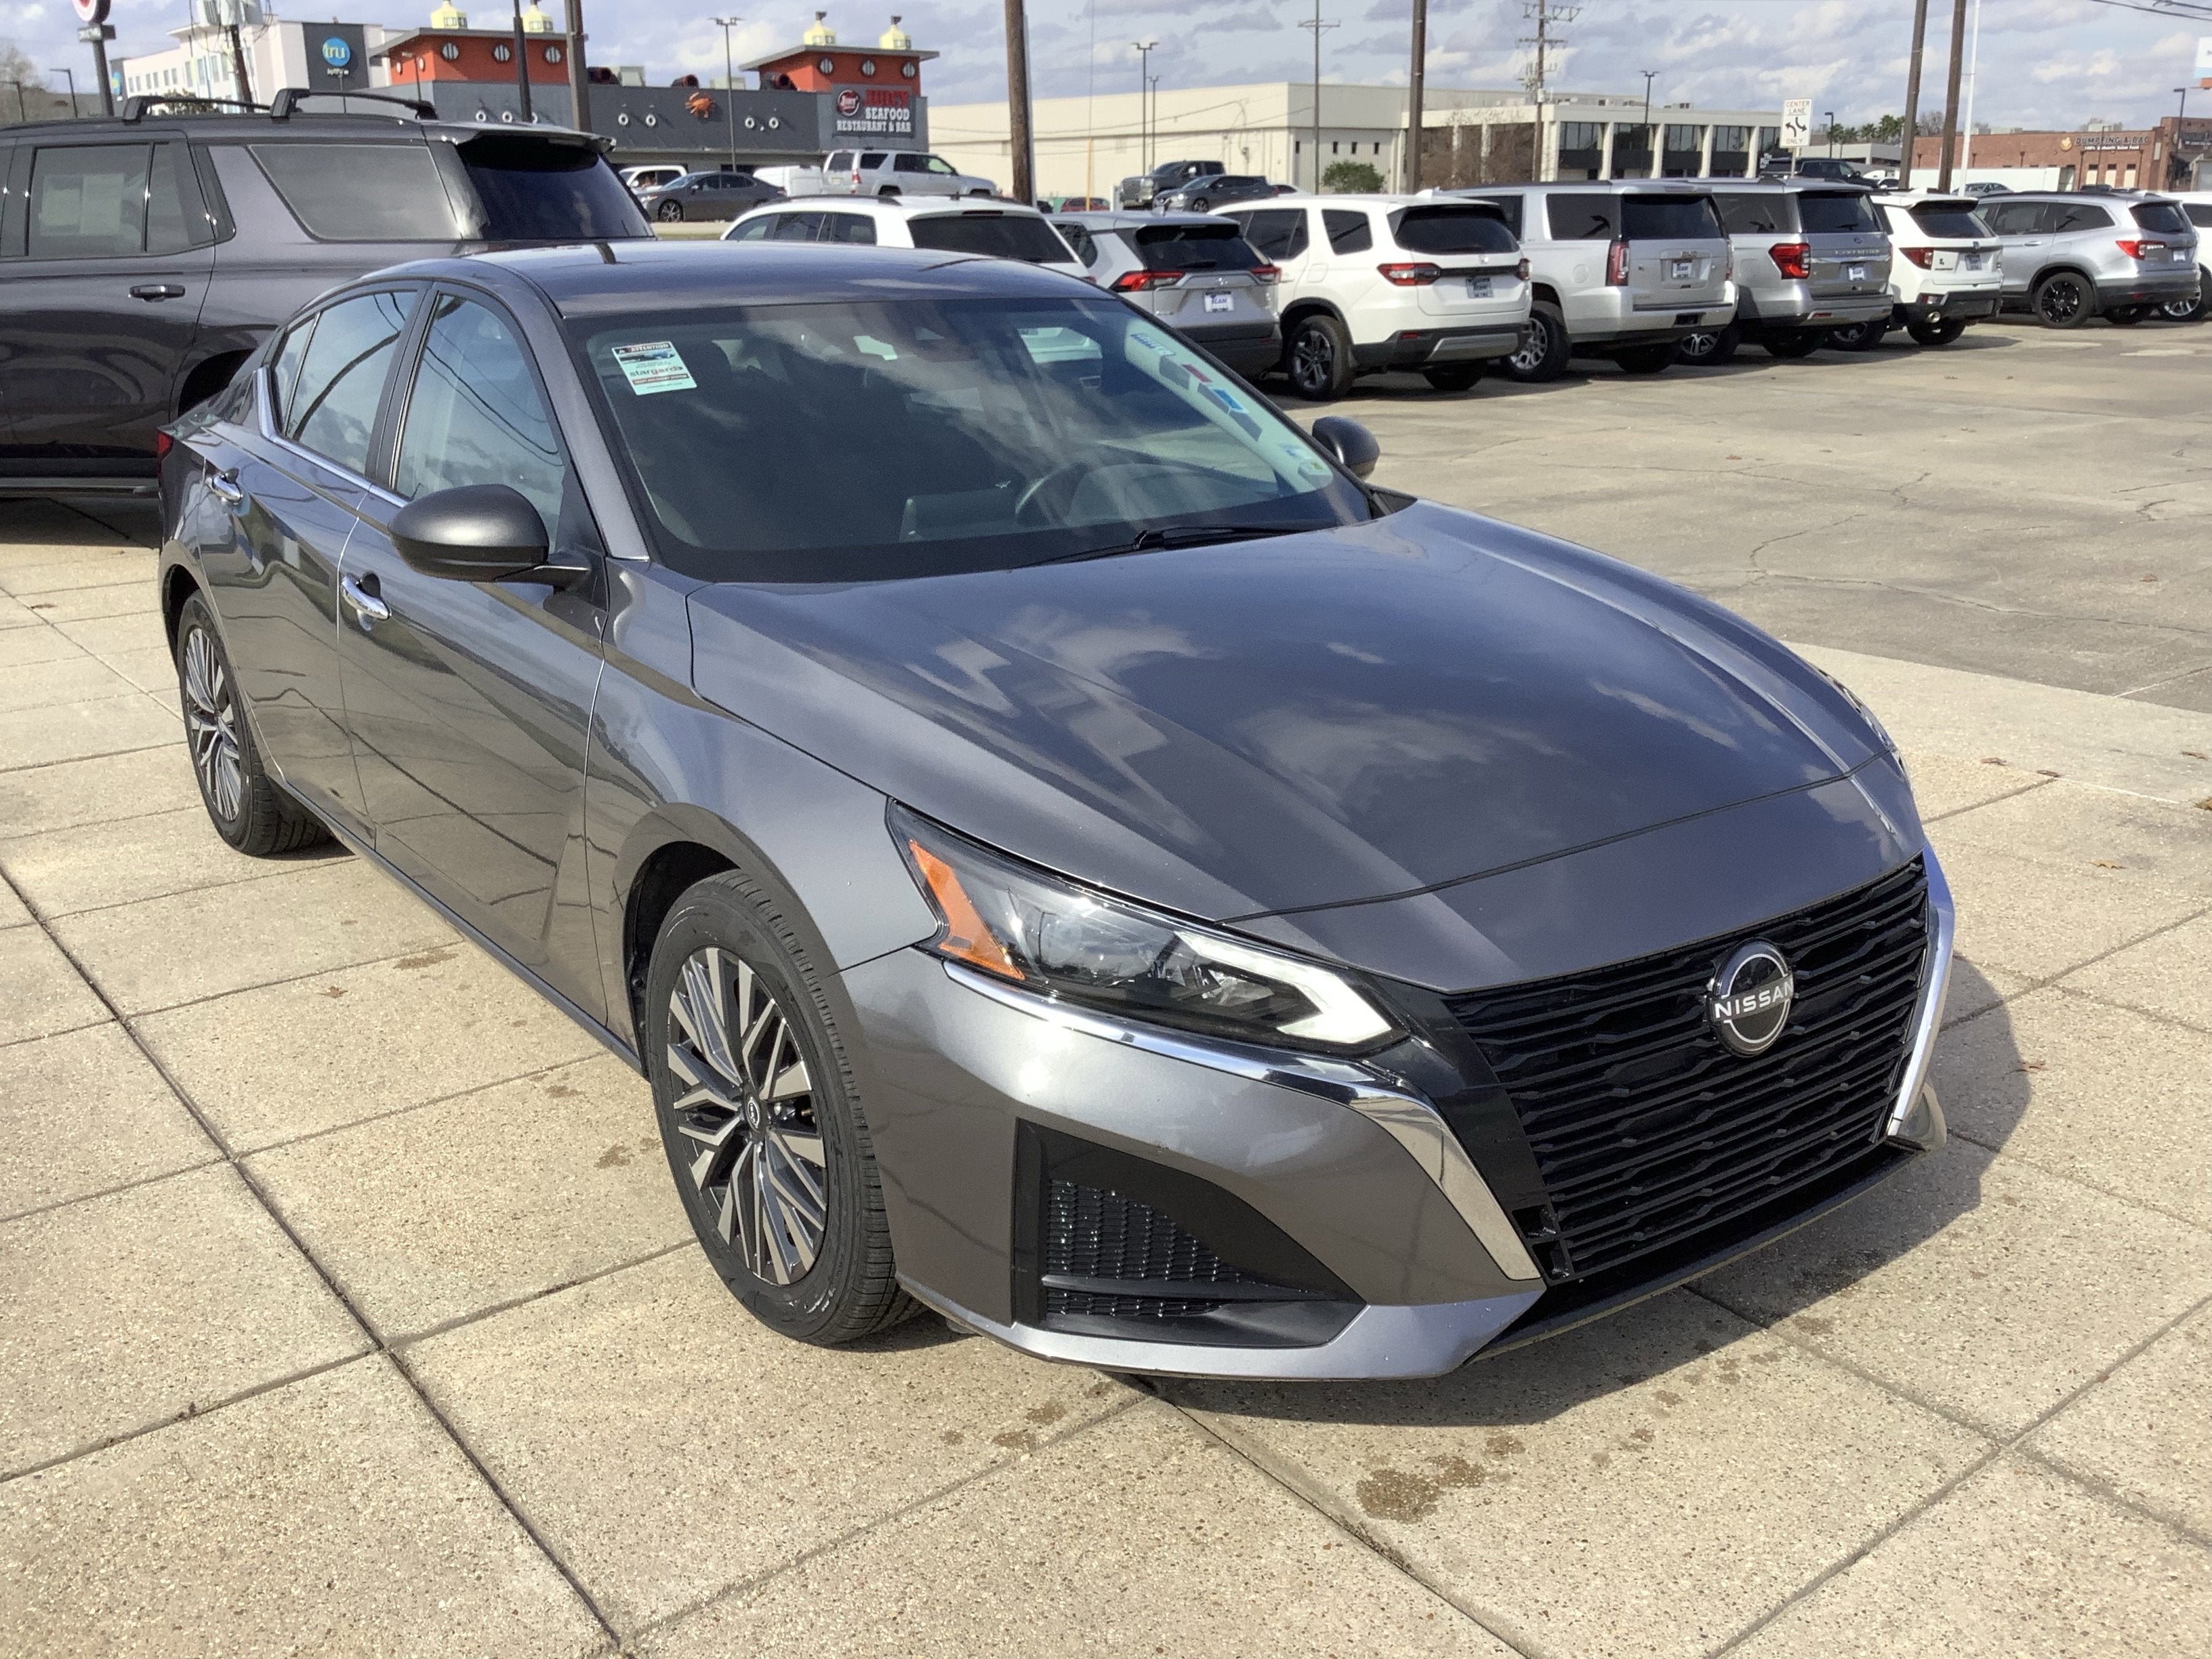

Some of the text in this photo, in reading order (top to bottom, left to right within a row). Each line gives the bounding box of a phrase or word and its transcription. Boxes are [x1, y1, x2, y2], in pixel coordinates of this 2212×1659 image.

[323, 43, 346, 60] tru
[865, 107, 910, 121] SEAFOOD
[836, 120, 912, 132] RESTAURANT & BAR
[2076, 137, 2121, 145] DUMPING
[1714, 973, 1795, 1019] NISSAN
